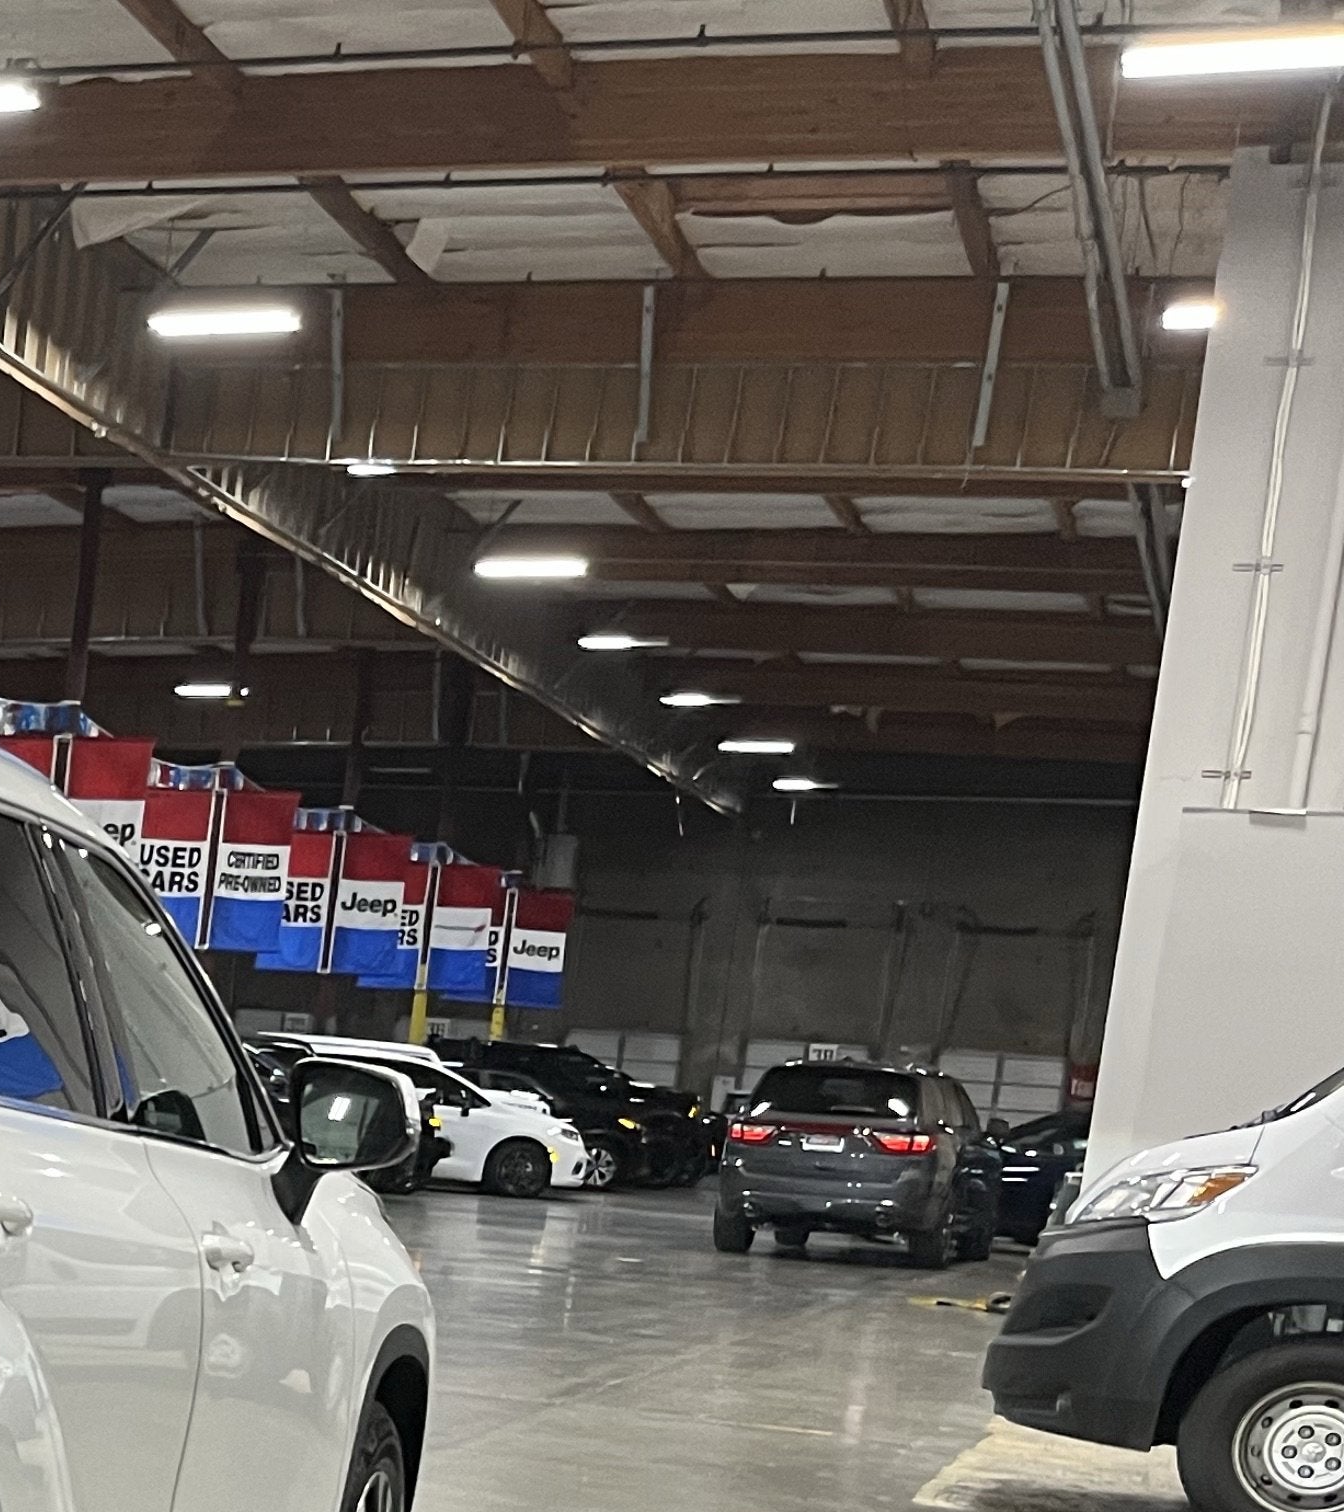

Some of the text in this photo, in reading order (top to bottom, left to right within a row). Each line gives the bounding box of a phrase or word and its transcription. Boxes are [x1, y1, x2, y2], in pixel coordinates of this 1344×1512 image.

[104, 823, 135, 847] ep
[140, 844, 201, 868] USED
[227, 850, 280, 870] CERTIFIED
[218, 872, 281, 893] PRE-OWNED
[285, 881, 324, 902] SED
[282, 904, 321, 923] ARS
[341, 892, 397, 918] Jeep
[513, 939, 560, 962] Jeep
